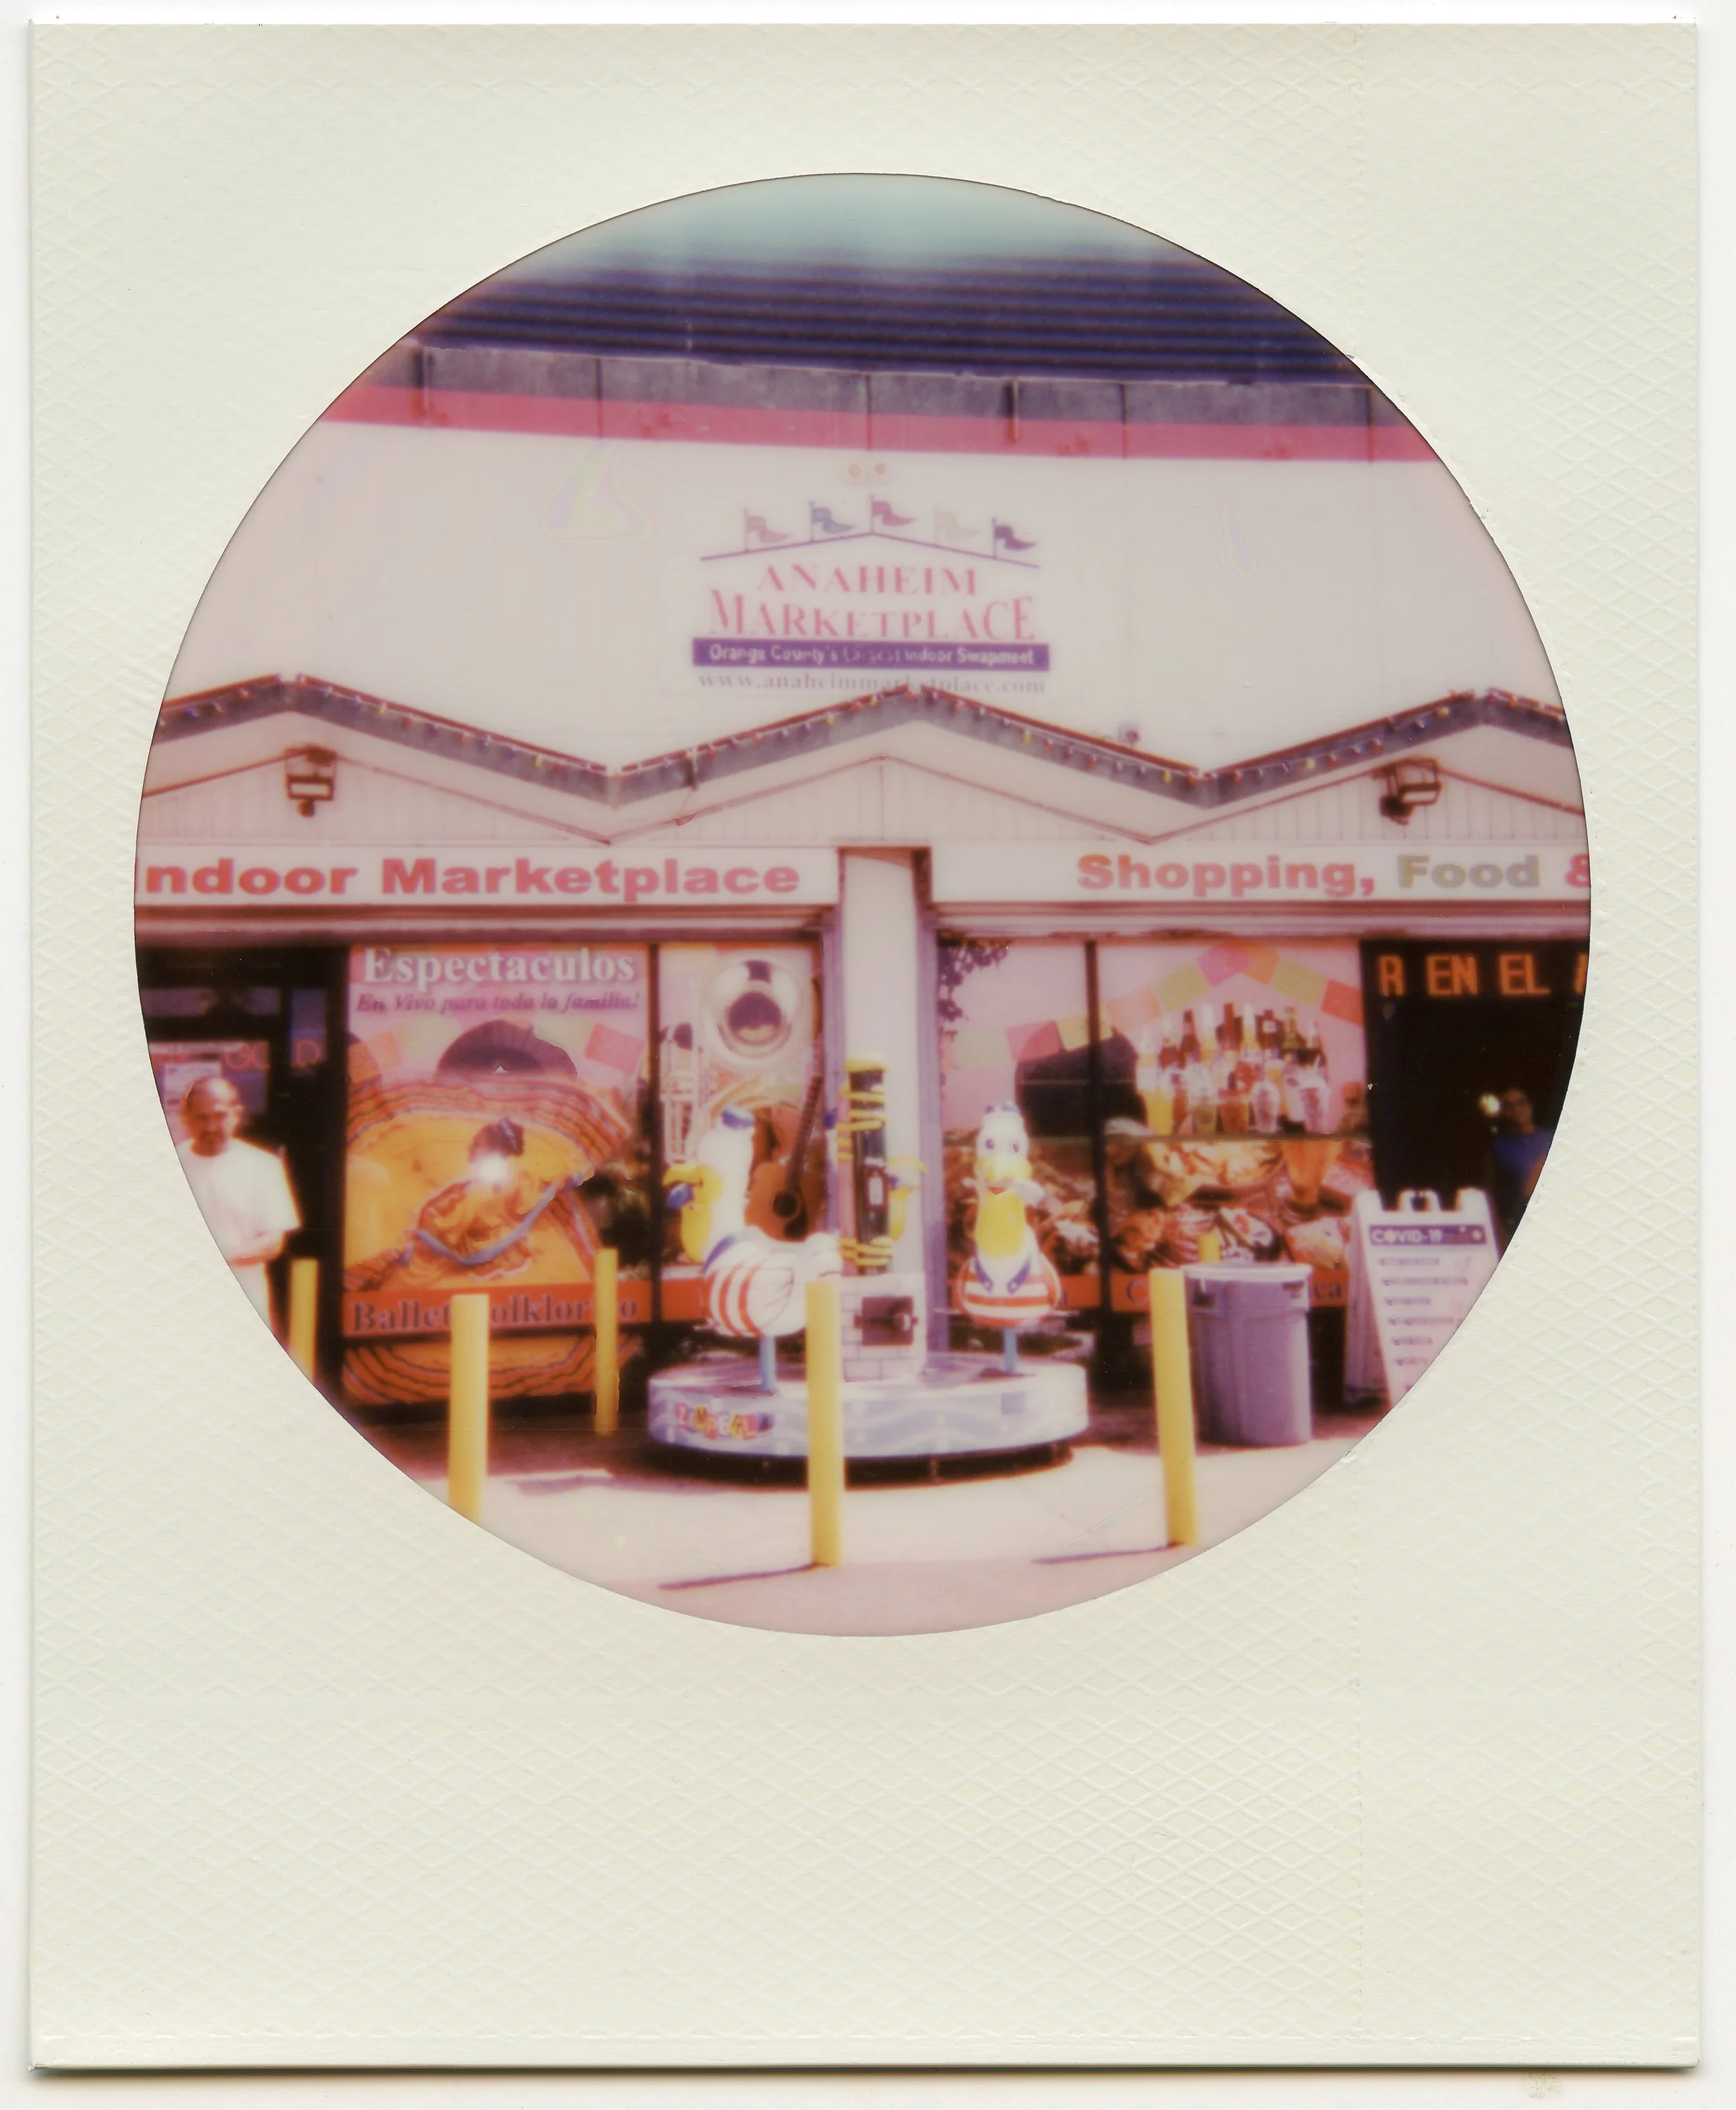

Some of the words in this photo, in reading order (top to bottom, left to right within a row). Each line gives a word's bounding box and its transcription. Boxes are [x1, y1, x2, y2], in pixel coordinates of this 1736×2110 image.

[757, 564, 978, 597] ANAHEIM
[710, 589, 1035, 640] MARKETPLACE
[709, 644, 767, 665] Orange
[770, 645, 838, 665] County's
[904, 647, 953, 663] Indoor
[956, 647, 1035, 667] Swapmeet
[135, 857, 358, 895] ndoor
[382, 858, 799, 904] Marketplace
[1077, 853, 1376, 897] Shopping,
[1398, 854, 1541, 888] Food
[1564, 853, 1592, 888] &
[364, 946, 635, 992] Espectaculos
[1378, 954, 1405, 997] R
[1426, 954, 1479, 996] EN
[1498, 953, 1551, 996] EL
[357, 992, 386, 1012] En
[394, 993, 437, 1011] Vivo
[440, 995, 487, 1015] para
[492, 992, 536, 1011] toda
[540, 991, 560, 1009] la
[562, 990, 642, 1013] familia!
[1371, 1227, 1443, 1244] COVID-19
[490, 1294, 637, 1324] olkloro
